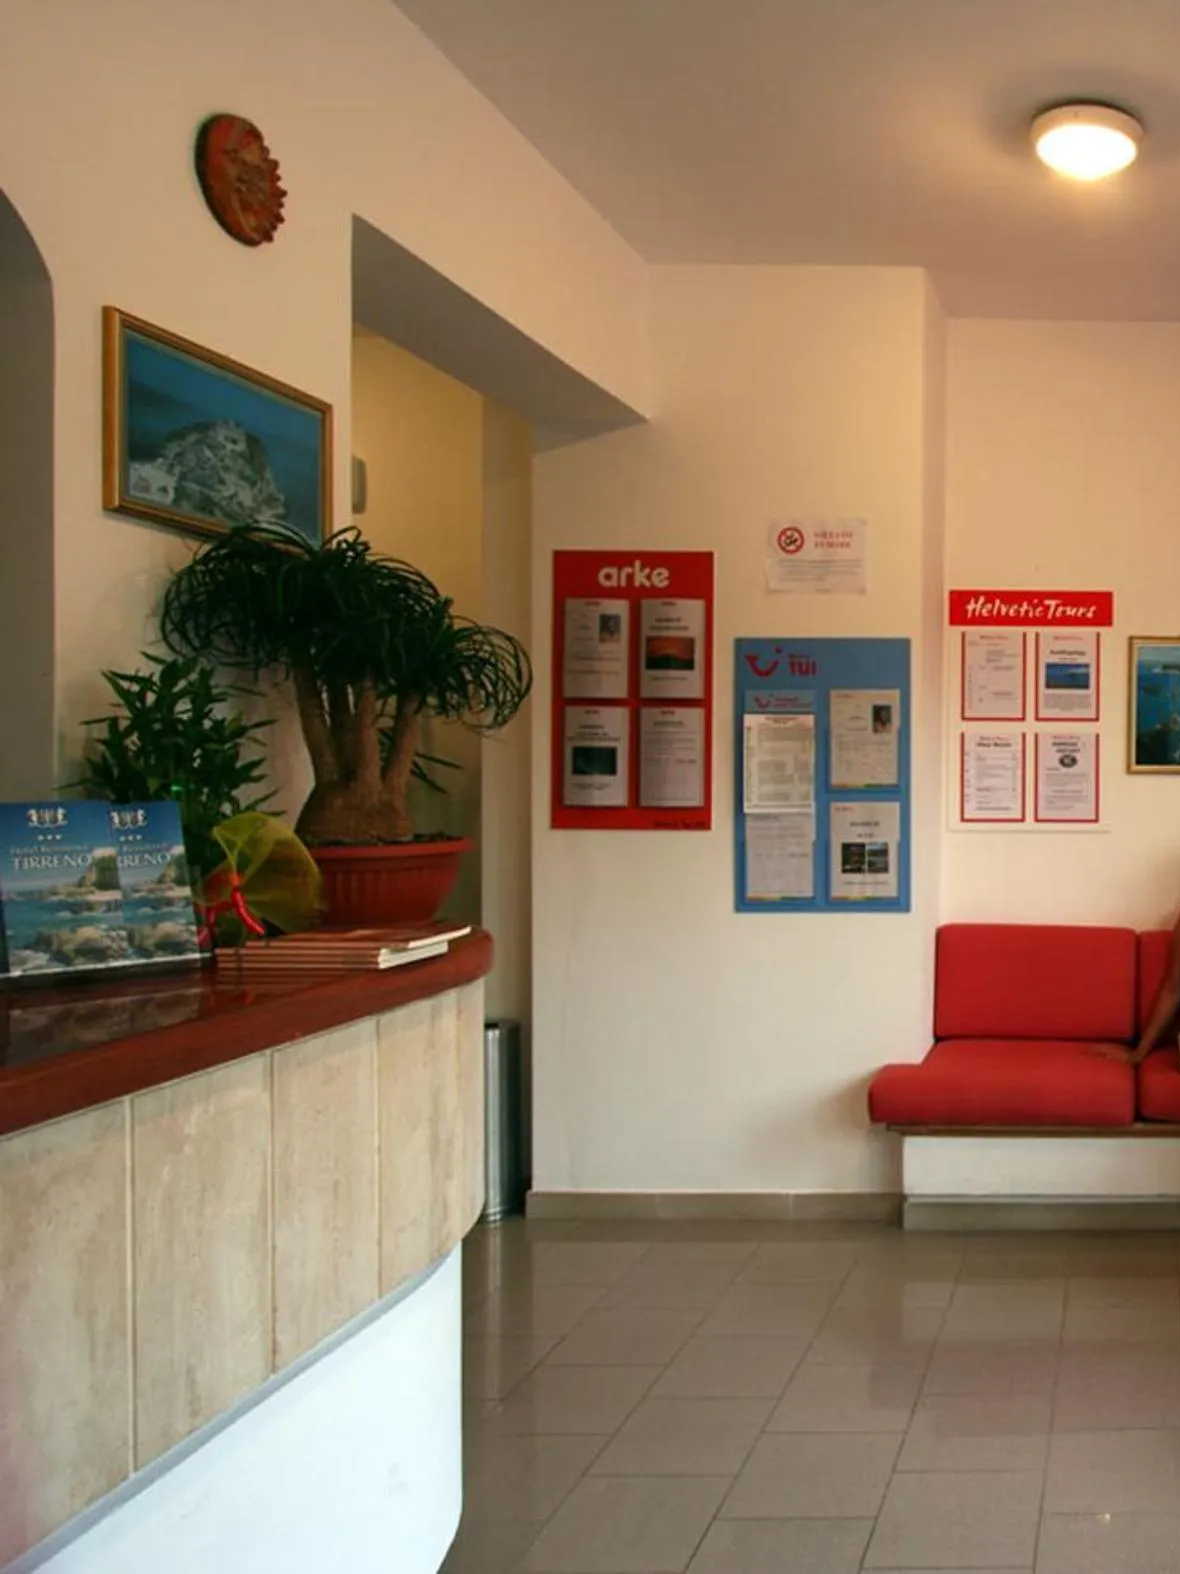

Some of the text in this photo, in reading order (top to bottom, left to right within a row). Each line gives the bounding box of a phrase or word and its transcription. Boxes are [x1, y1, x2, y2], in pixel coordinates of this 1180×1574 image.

[597, 559, 671, 588] arke
[965, 594, 1097, 619] Helvetic Tours
[787, 657, 817, 676] TUI
[12, 853, 92, 871] TIRRENO
